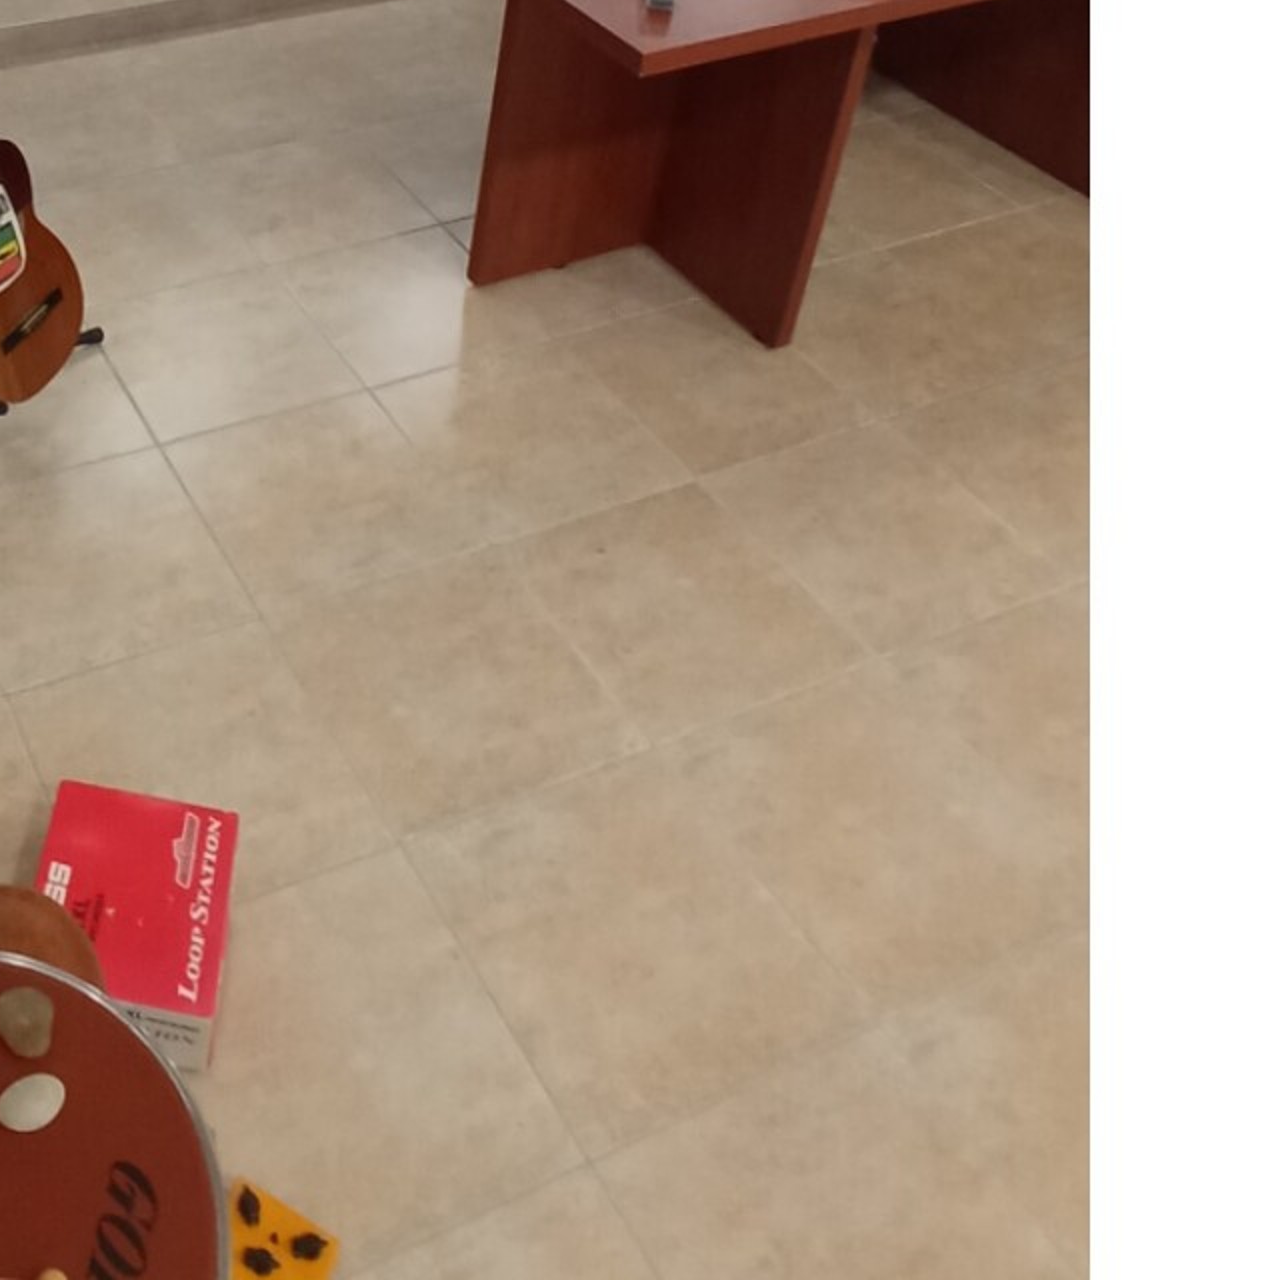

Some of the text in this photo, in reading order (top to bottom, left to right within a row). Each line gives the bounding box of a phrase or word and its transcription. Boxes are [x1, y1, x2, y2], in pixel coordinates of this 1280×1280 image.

[43, 859, 73, 907] SS
[190, 816, 223, 926] STATION
[177, 926, 207, 1003] LOOP
